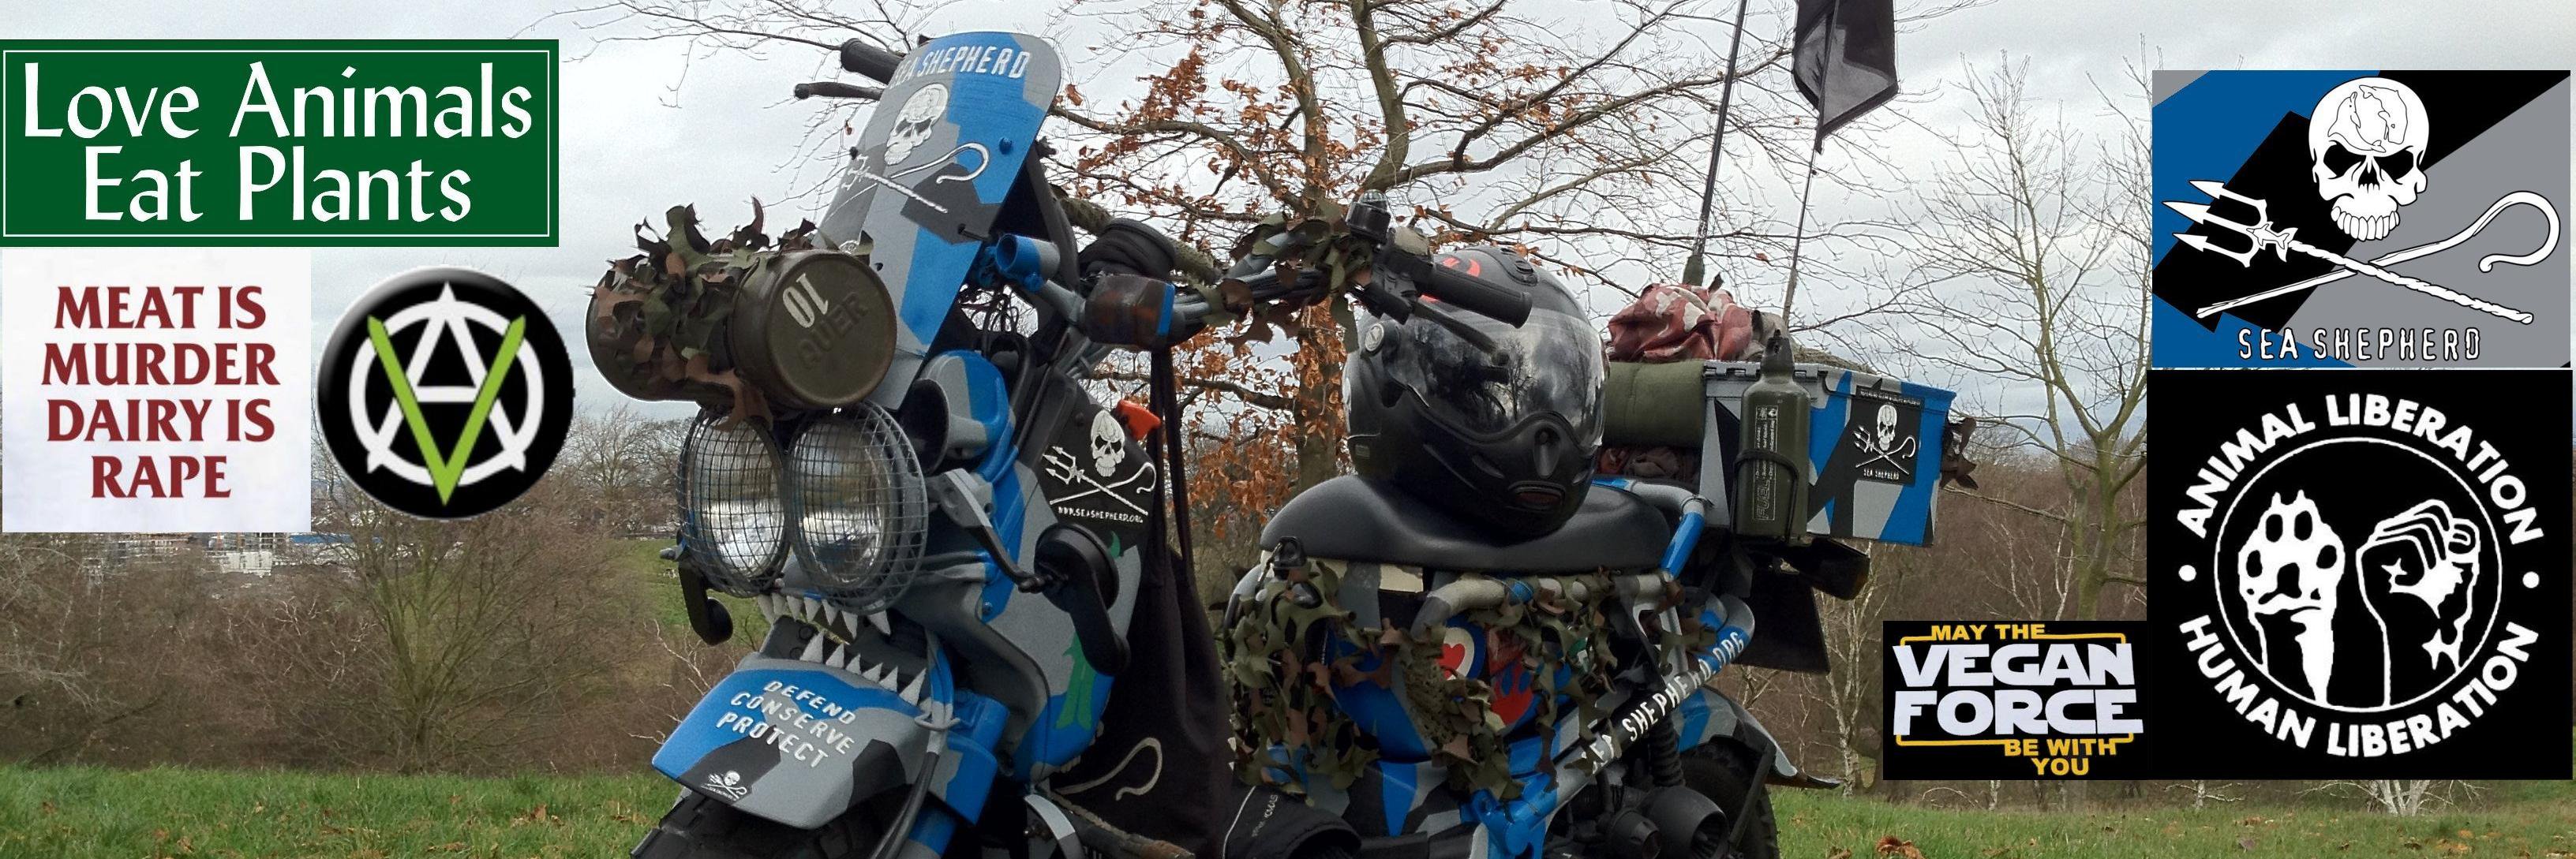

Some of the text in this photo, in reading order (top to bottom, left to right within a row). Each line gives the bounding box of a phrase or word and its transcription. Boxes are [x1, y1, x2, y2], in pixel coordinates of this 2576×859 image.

[917, 45, 1031, 79] SHEPHERD
[783, 273, 828, 328] 10
[731, 692, 855, 755] CONSERVE
[763, 681, 856, 725] DEFEND
[716, 711, 829, 768] PROTECT
